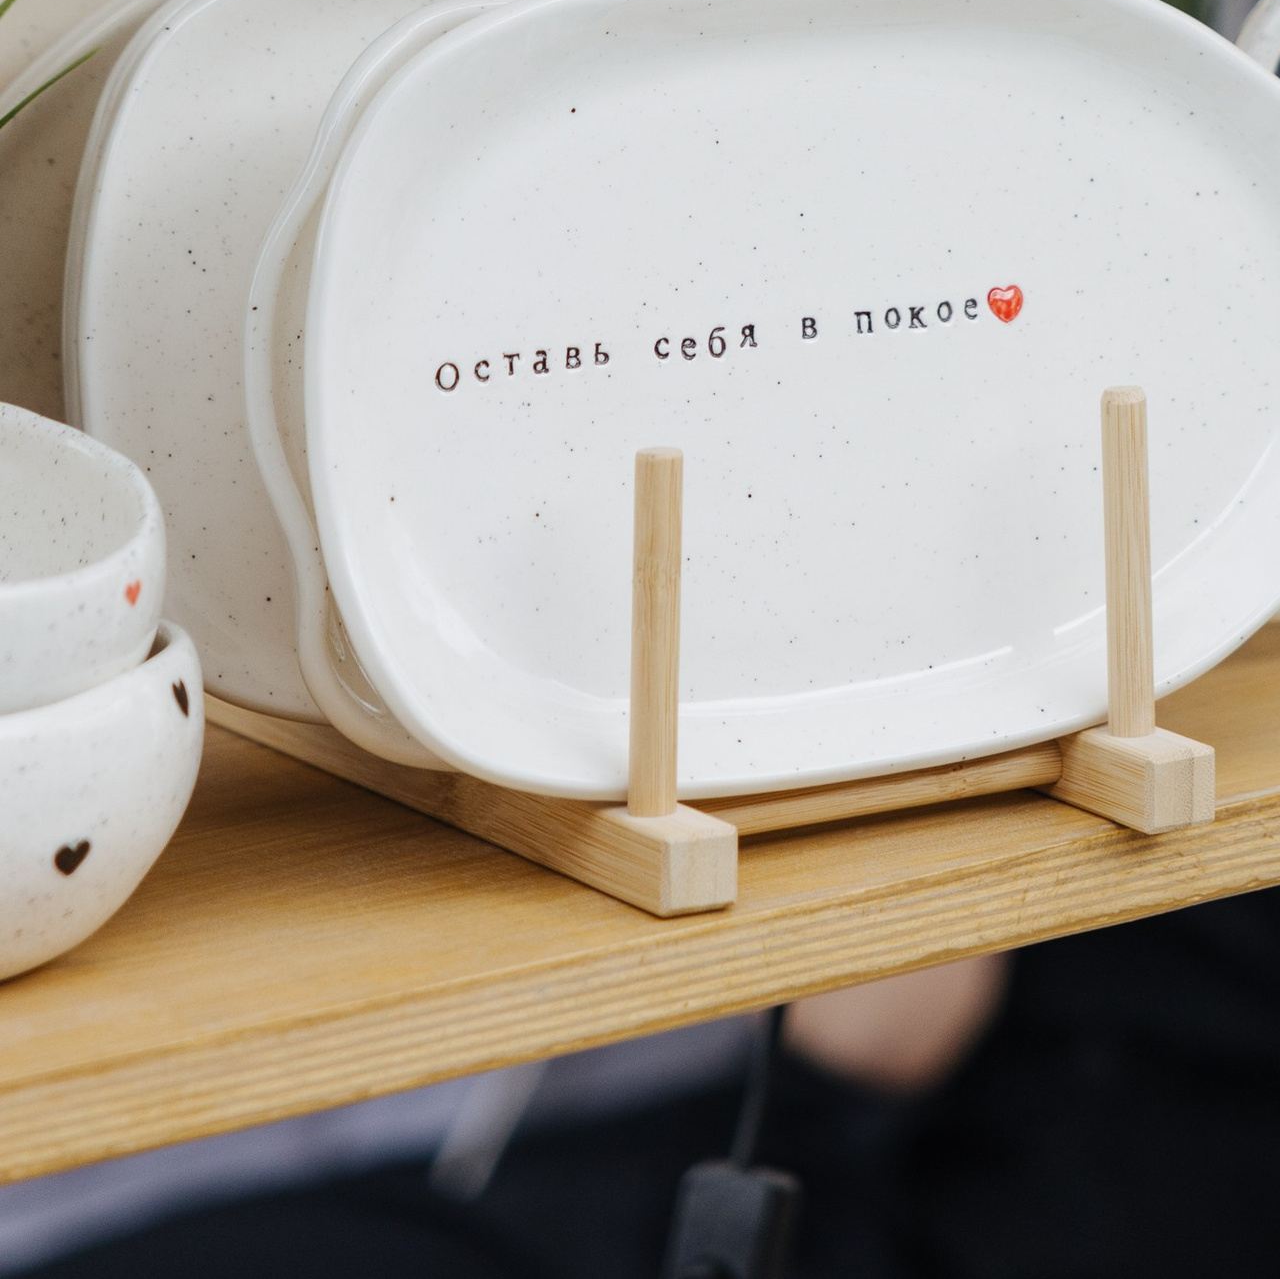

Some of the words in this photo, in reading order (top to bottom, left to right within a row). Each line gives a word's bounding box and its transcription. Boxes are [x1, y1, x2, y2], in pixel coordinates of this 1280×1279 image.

[434, 341, 611, 393] Оставь
[652, 323, 759, 362] себя
[801, 315, 819, 341] в
[854, 297, 979, 336] покое
